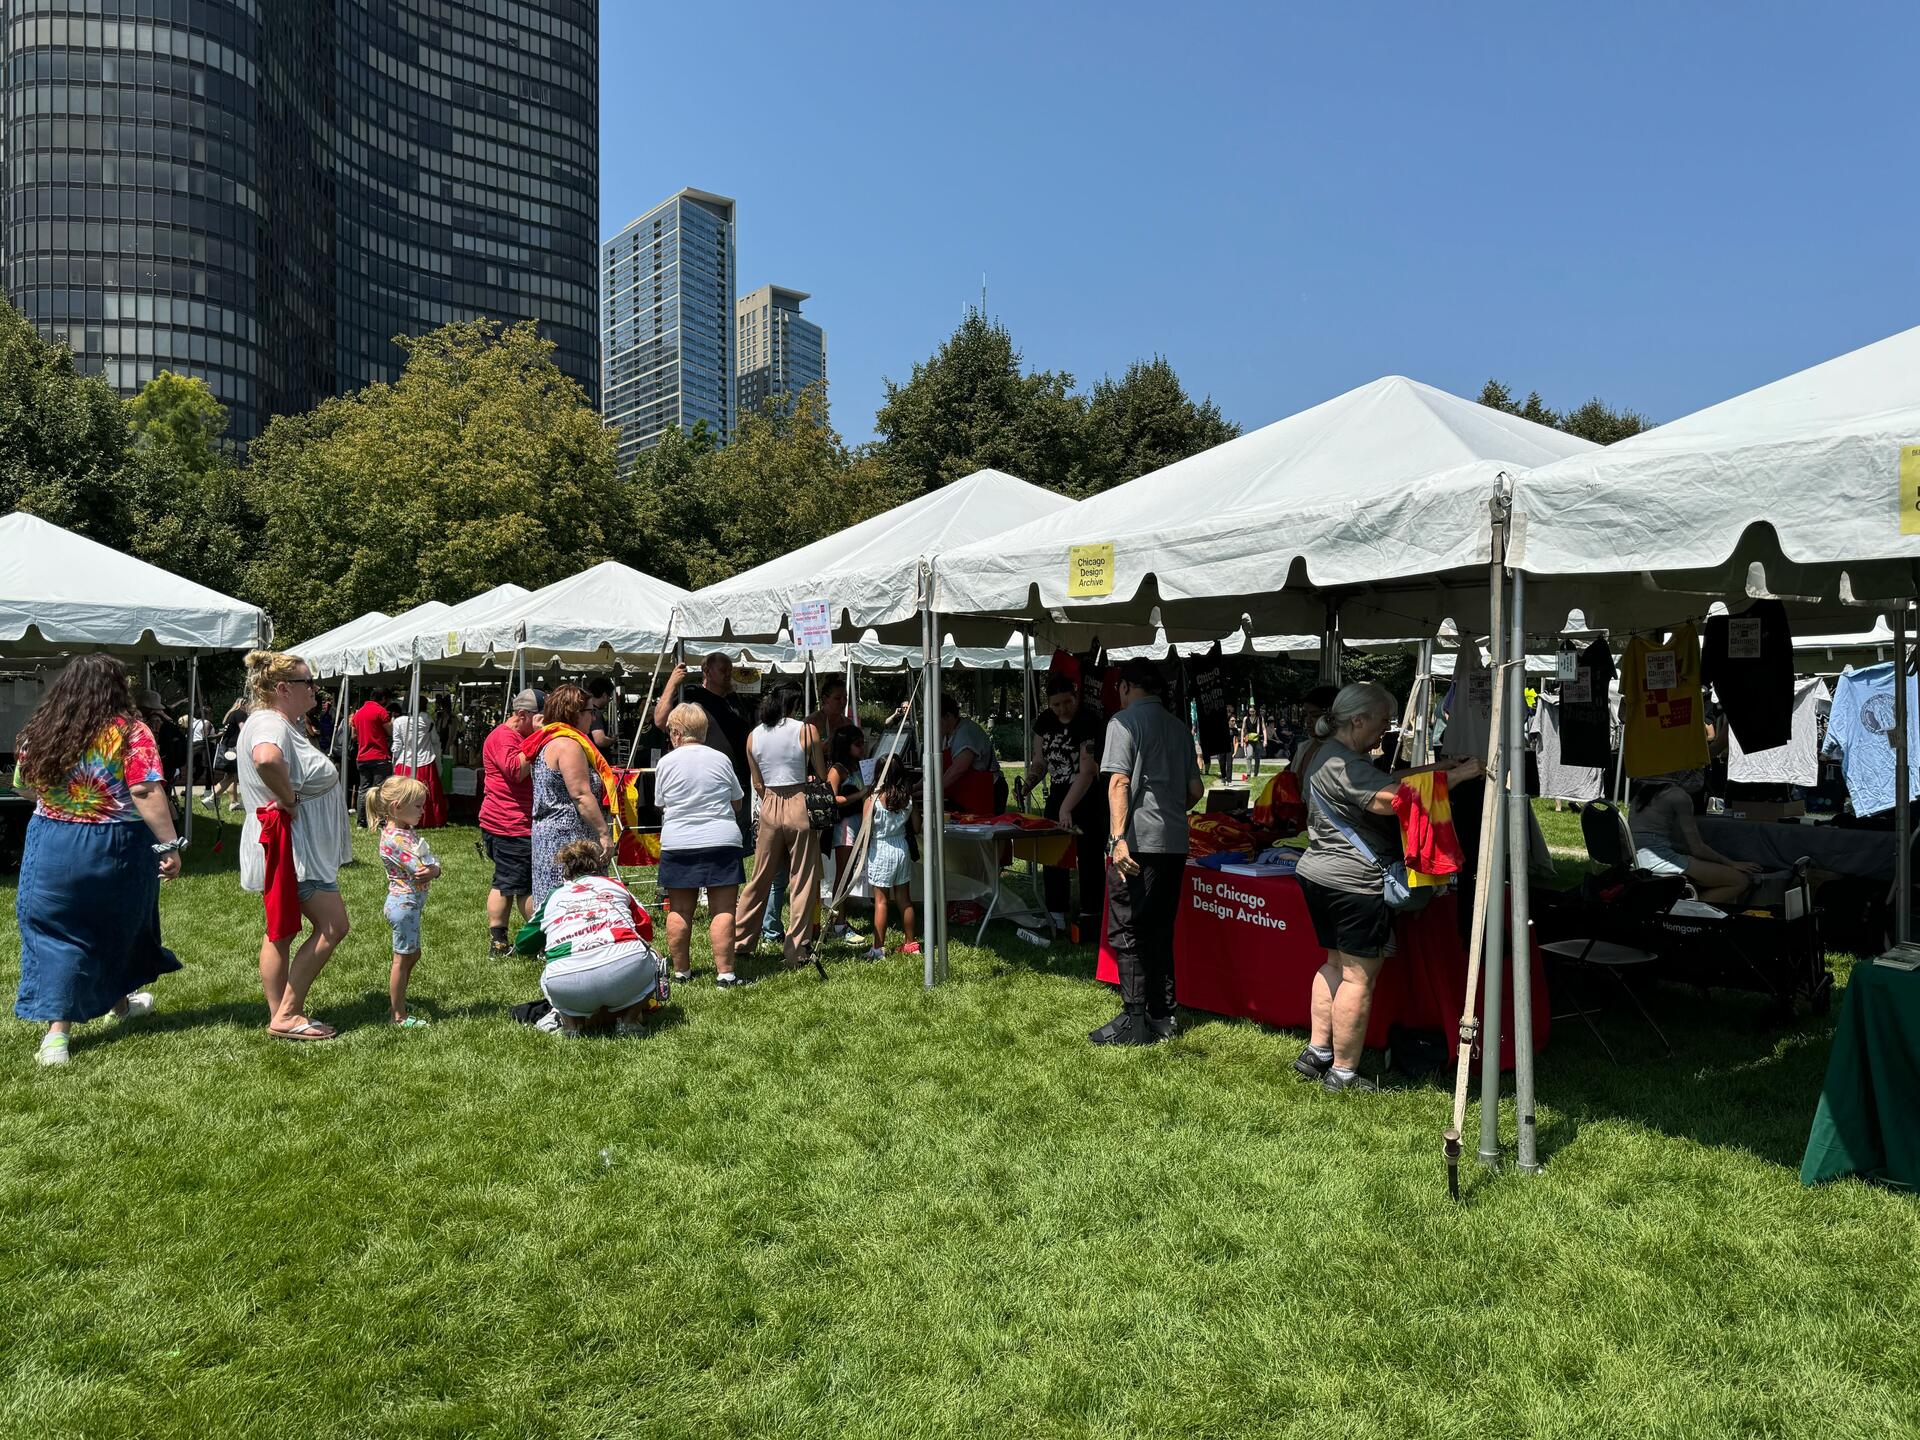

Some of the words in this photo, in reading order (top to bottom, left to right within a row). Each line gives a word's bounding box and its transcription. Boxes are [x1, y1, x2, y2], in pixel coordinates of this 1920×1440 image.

[1078, 558, 1105, 567] Chicago
[1081, 567, 1104, 577] Design
[1078, 578, 1104, 587] Archive
[1192, 877, 1213, 894] The
[1215, 883, 1266, 910] Chicago
[1193, 895, 1234, 919] Design
[1236, 907, 1287, 931] Archive
